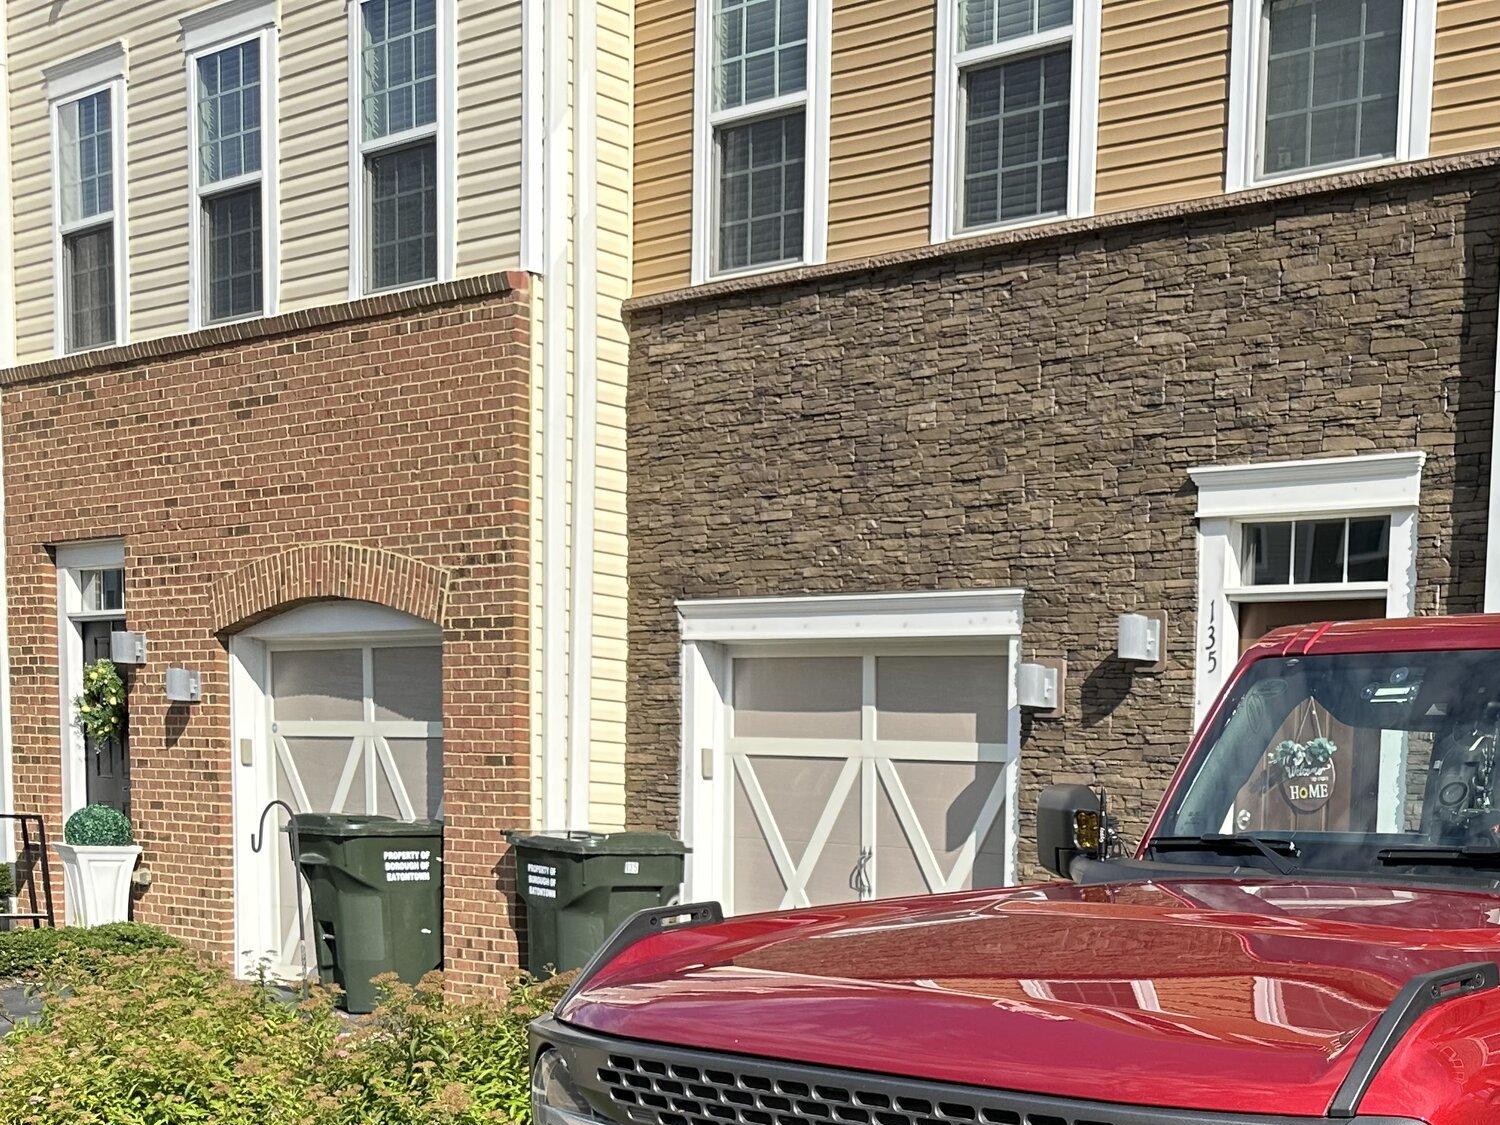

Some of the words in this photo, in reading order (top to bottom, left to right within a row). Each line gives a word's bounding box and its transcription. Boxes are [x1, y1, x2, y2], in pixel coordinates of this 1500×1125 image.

[1205, 600, 1217, 674] 135
[1290, 784, 1328, 800] HOME
[383, 850, 420, 861] PROPERTY
[420, 850, 431, 860] OF
[385, 861, 420, 871] BOROUGH
[420, 861, 430, 870] OF
